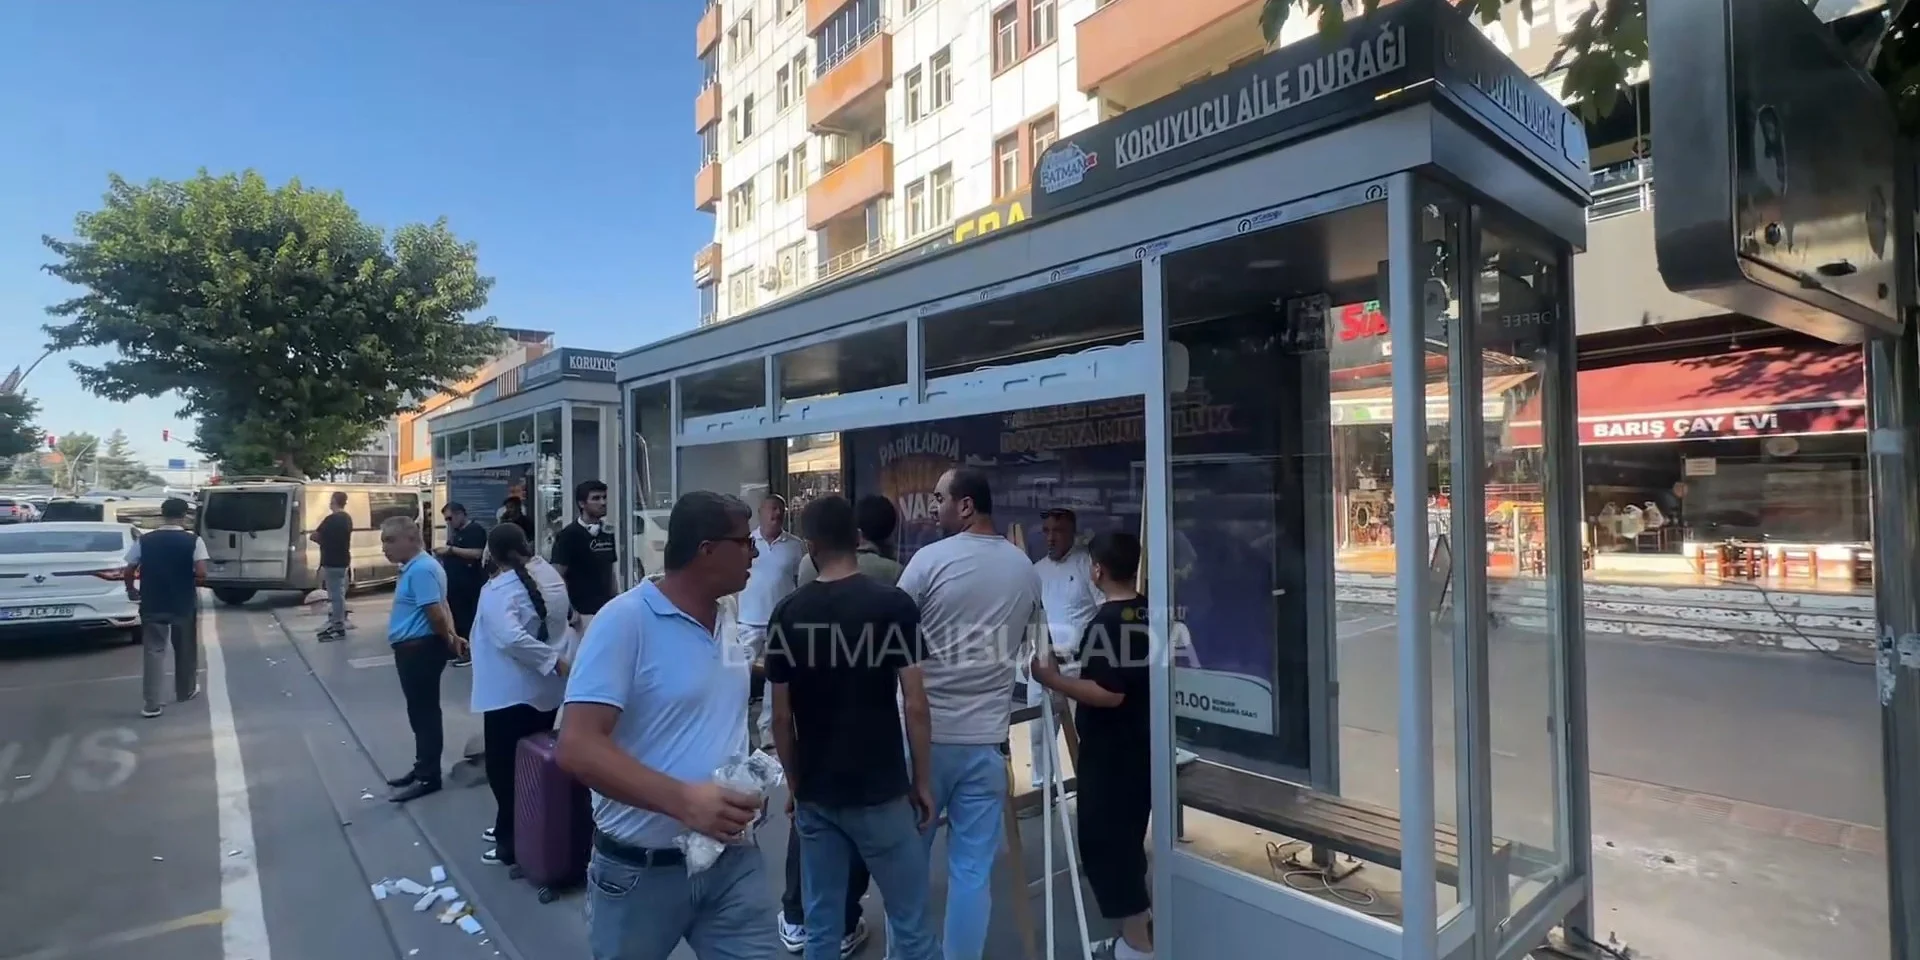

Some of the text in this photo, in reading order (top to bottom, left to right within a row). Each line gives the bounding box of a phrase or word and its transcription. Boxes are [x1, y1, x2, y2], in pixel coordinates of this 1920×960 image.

[1114, 93, 1231, 170] KORUYUCU
[1236, 72, 1291, 124] AİLE
[1299, 22, 1406, 101] DURAĞI
[1042, 157, 1085, 184] BATMAN
[569, 355, 618, 373] KORUYUC
[1593, 420, 1666, 438] BARIŞ
[1673, 416, 1725, 437] ÇAY
[879, 432, 960, 467] PARKLARDA
